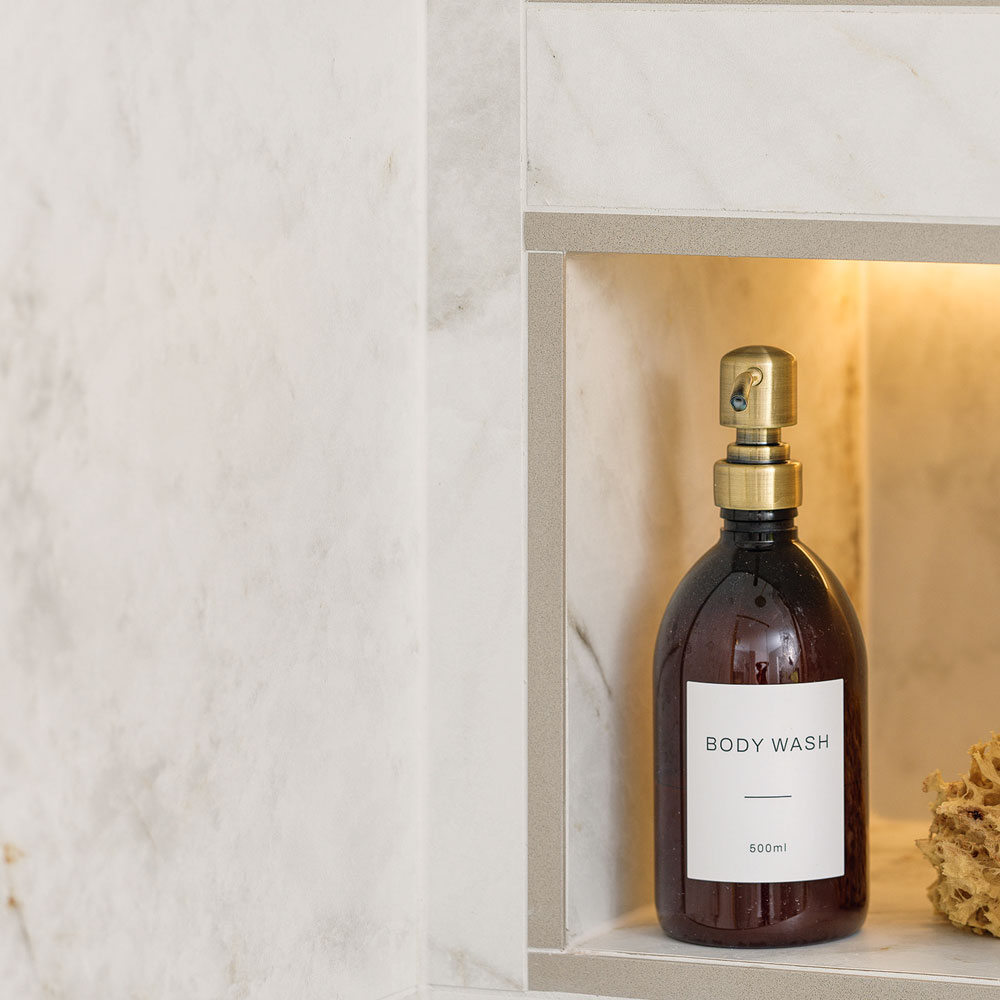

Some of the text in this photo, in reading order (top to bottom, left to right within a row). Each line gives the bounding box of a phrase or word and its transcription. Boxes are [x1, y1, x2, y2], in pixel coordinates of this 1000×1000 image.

[706, 734, 829, 753] BODY WASH
[749, 842, 787, 854] 500ml
